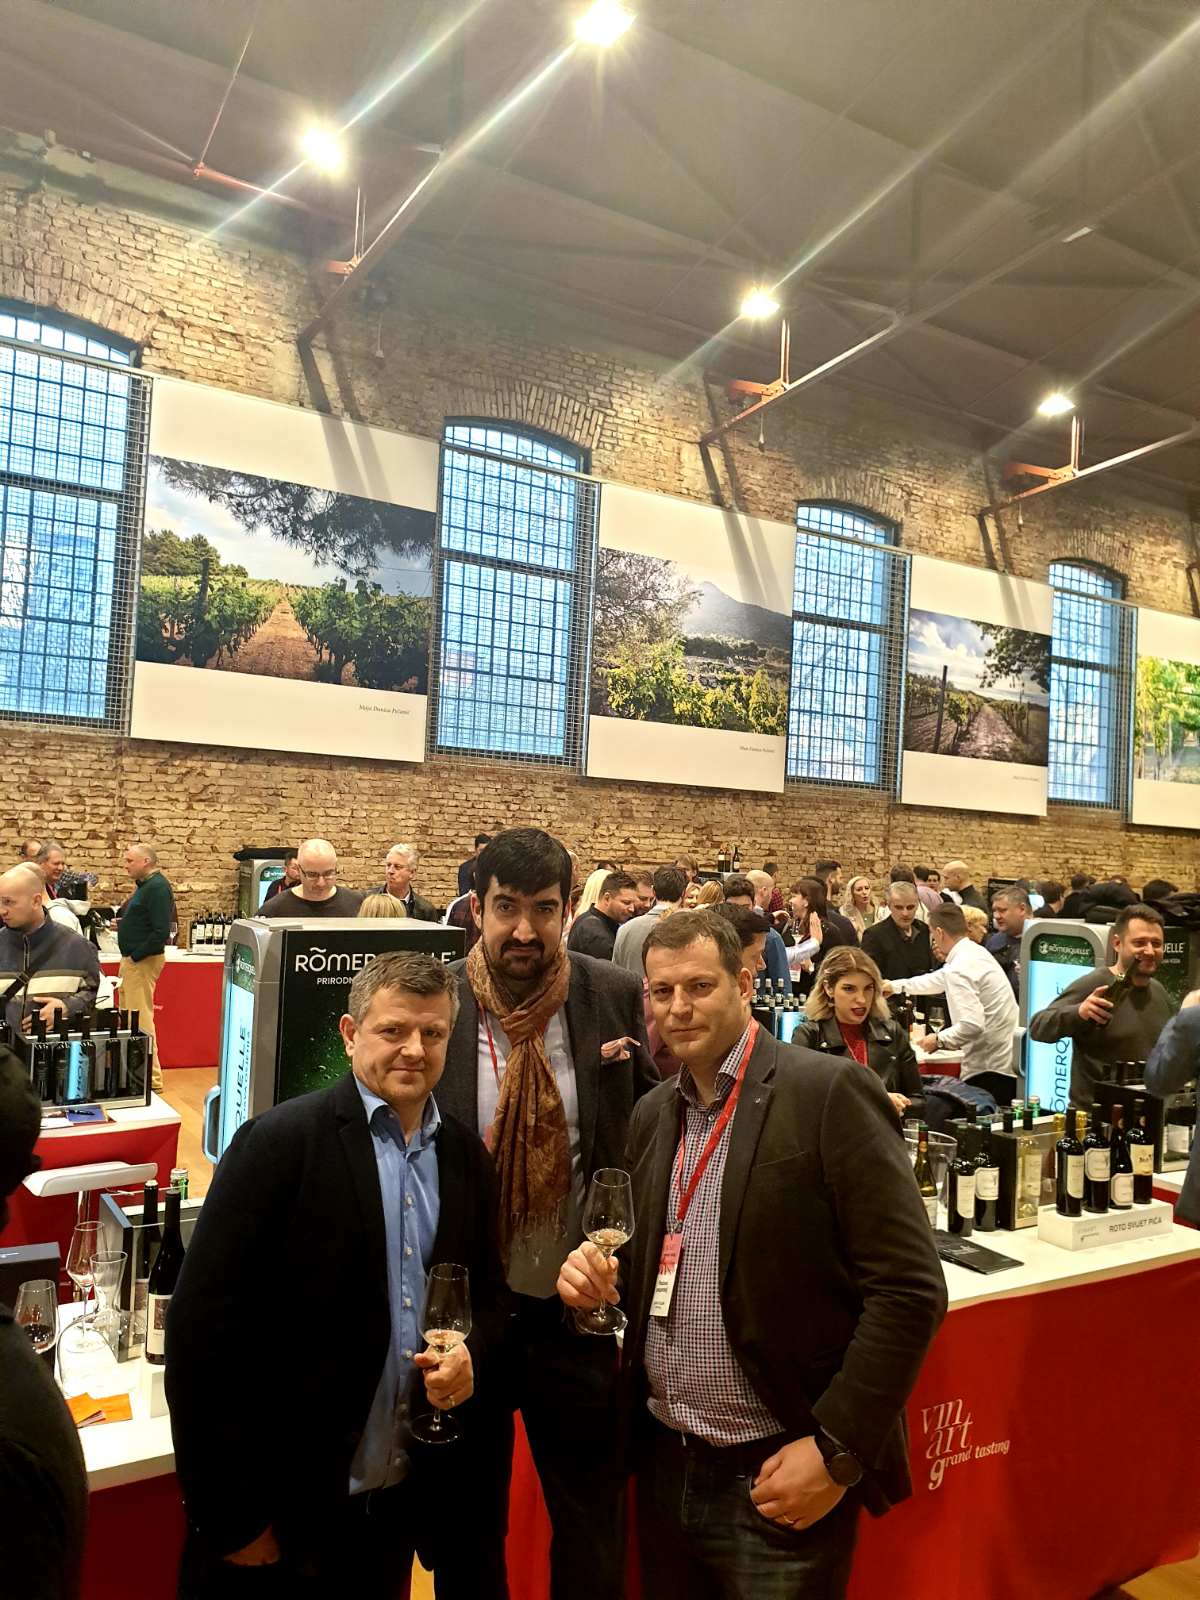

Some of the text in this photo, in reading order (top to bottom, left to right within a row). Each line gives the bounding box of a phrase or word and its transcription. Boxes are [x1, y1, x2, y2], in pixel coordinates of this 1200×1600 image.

[316, 976, 354, 986] PRIRODN
[235, 1027, 246, 1129] QUELLE
[926, 1412, 973, 1460] art
[928, 1440, 1010, 1491] grand tasting
